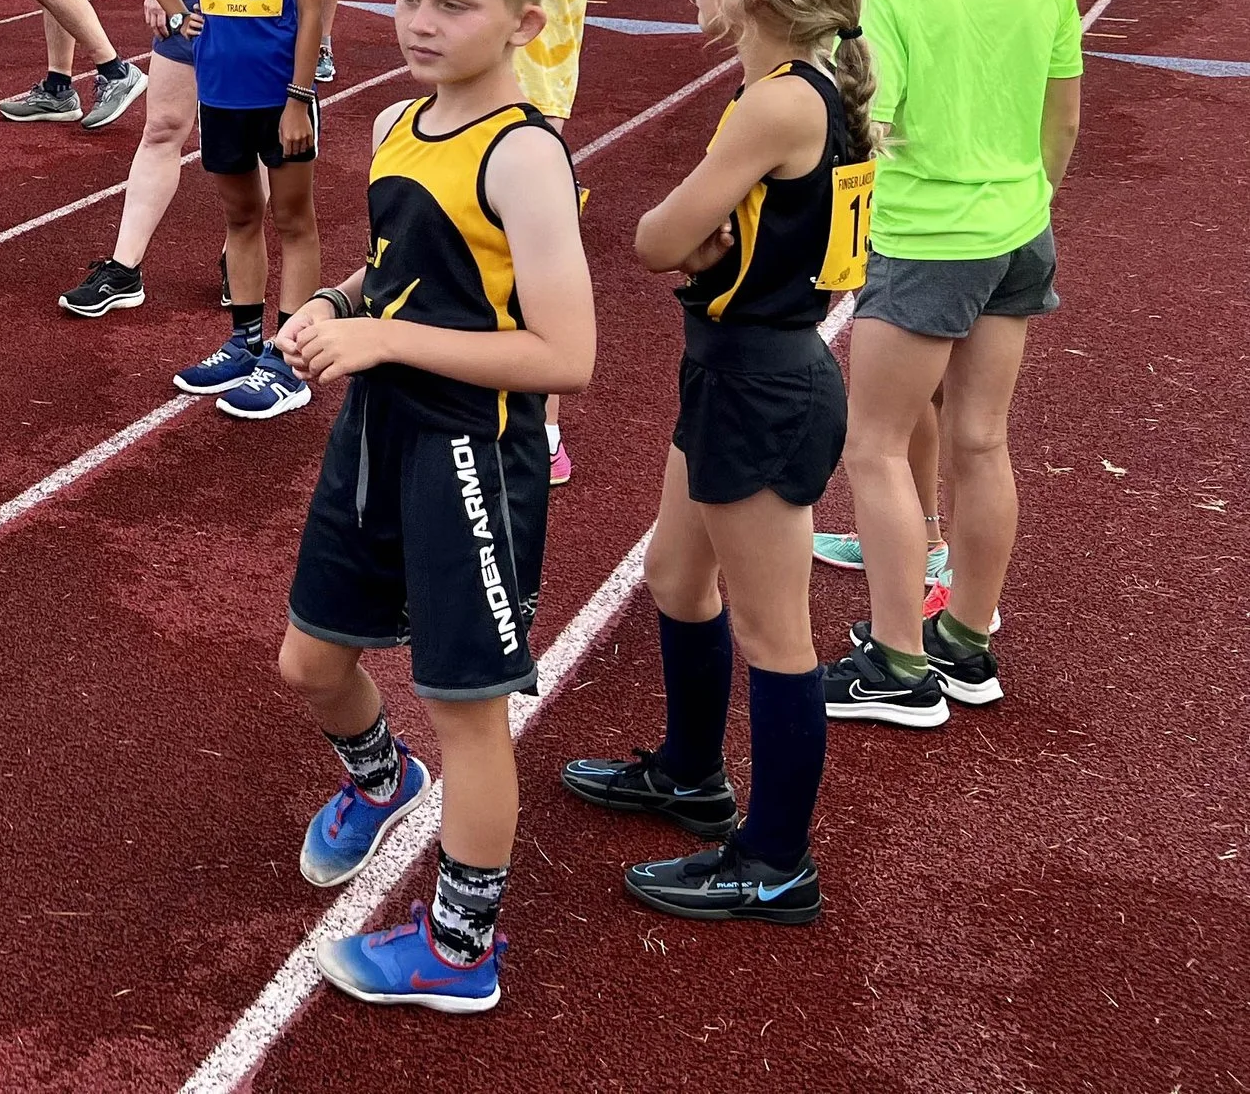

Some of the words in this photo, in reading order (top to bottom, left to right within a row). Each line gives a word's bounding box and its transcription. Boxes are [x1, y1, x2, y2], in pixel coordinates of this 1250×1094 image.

[227, 4, 247, 12] TRACK
[838, 175, 859, 191] FINGER
[450, 434, 494, 540] ARMOU
[479, 543, 519, 656] UNDER
